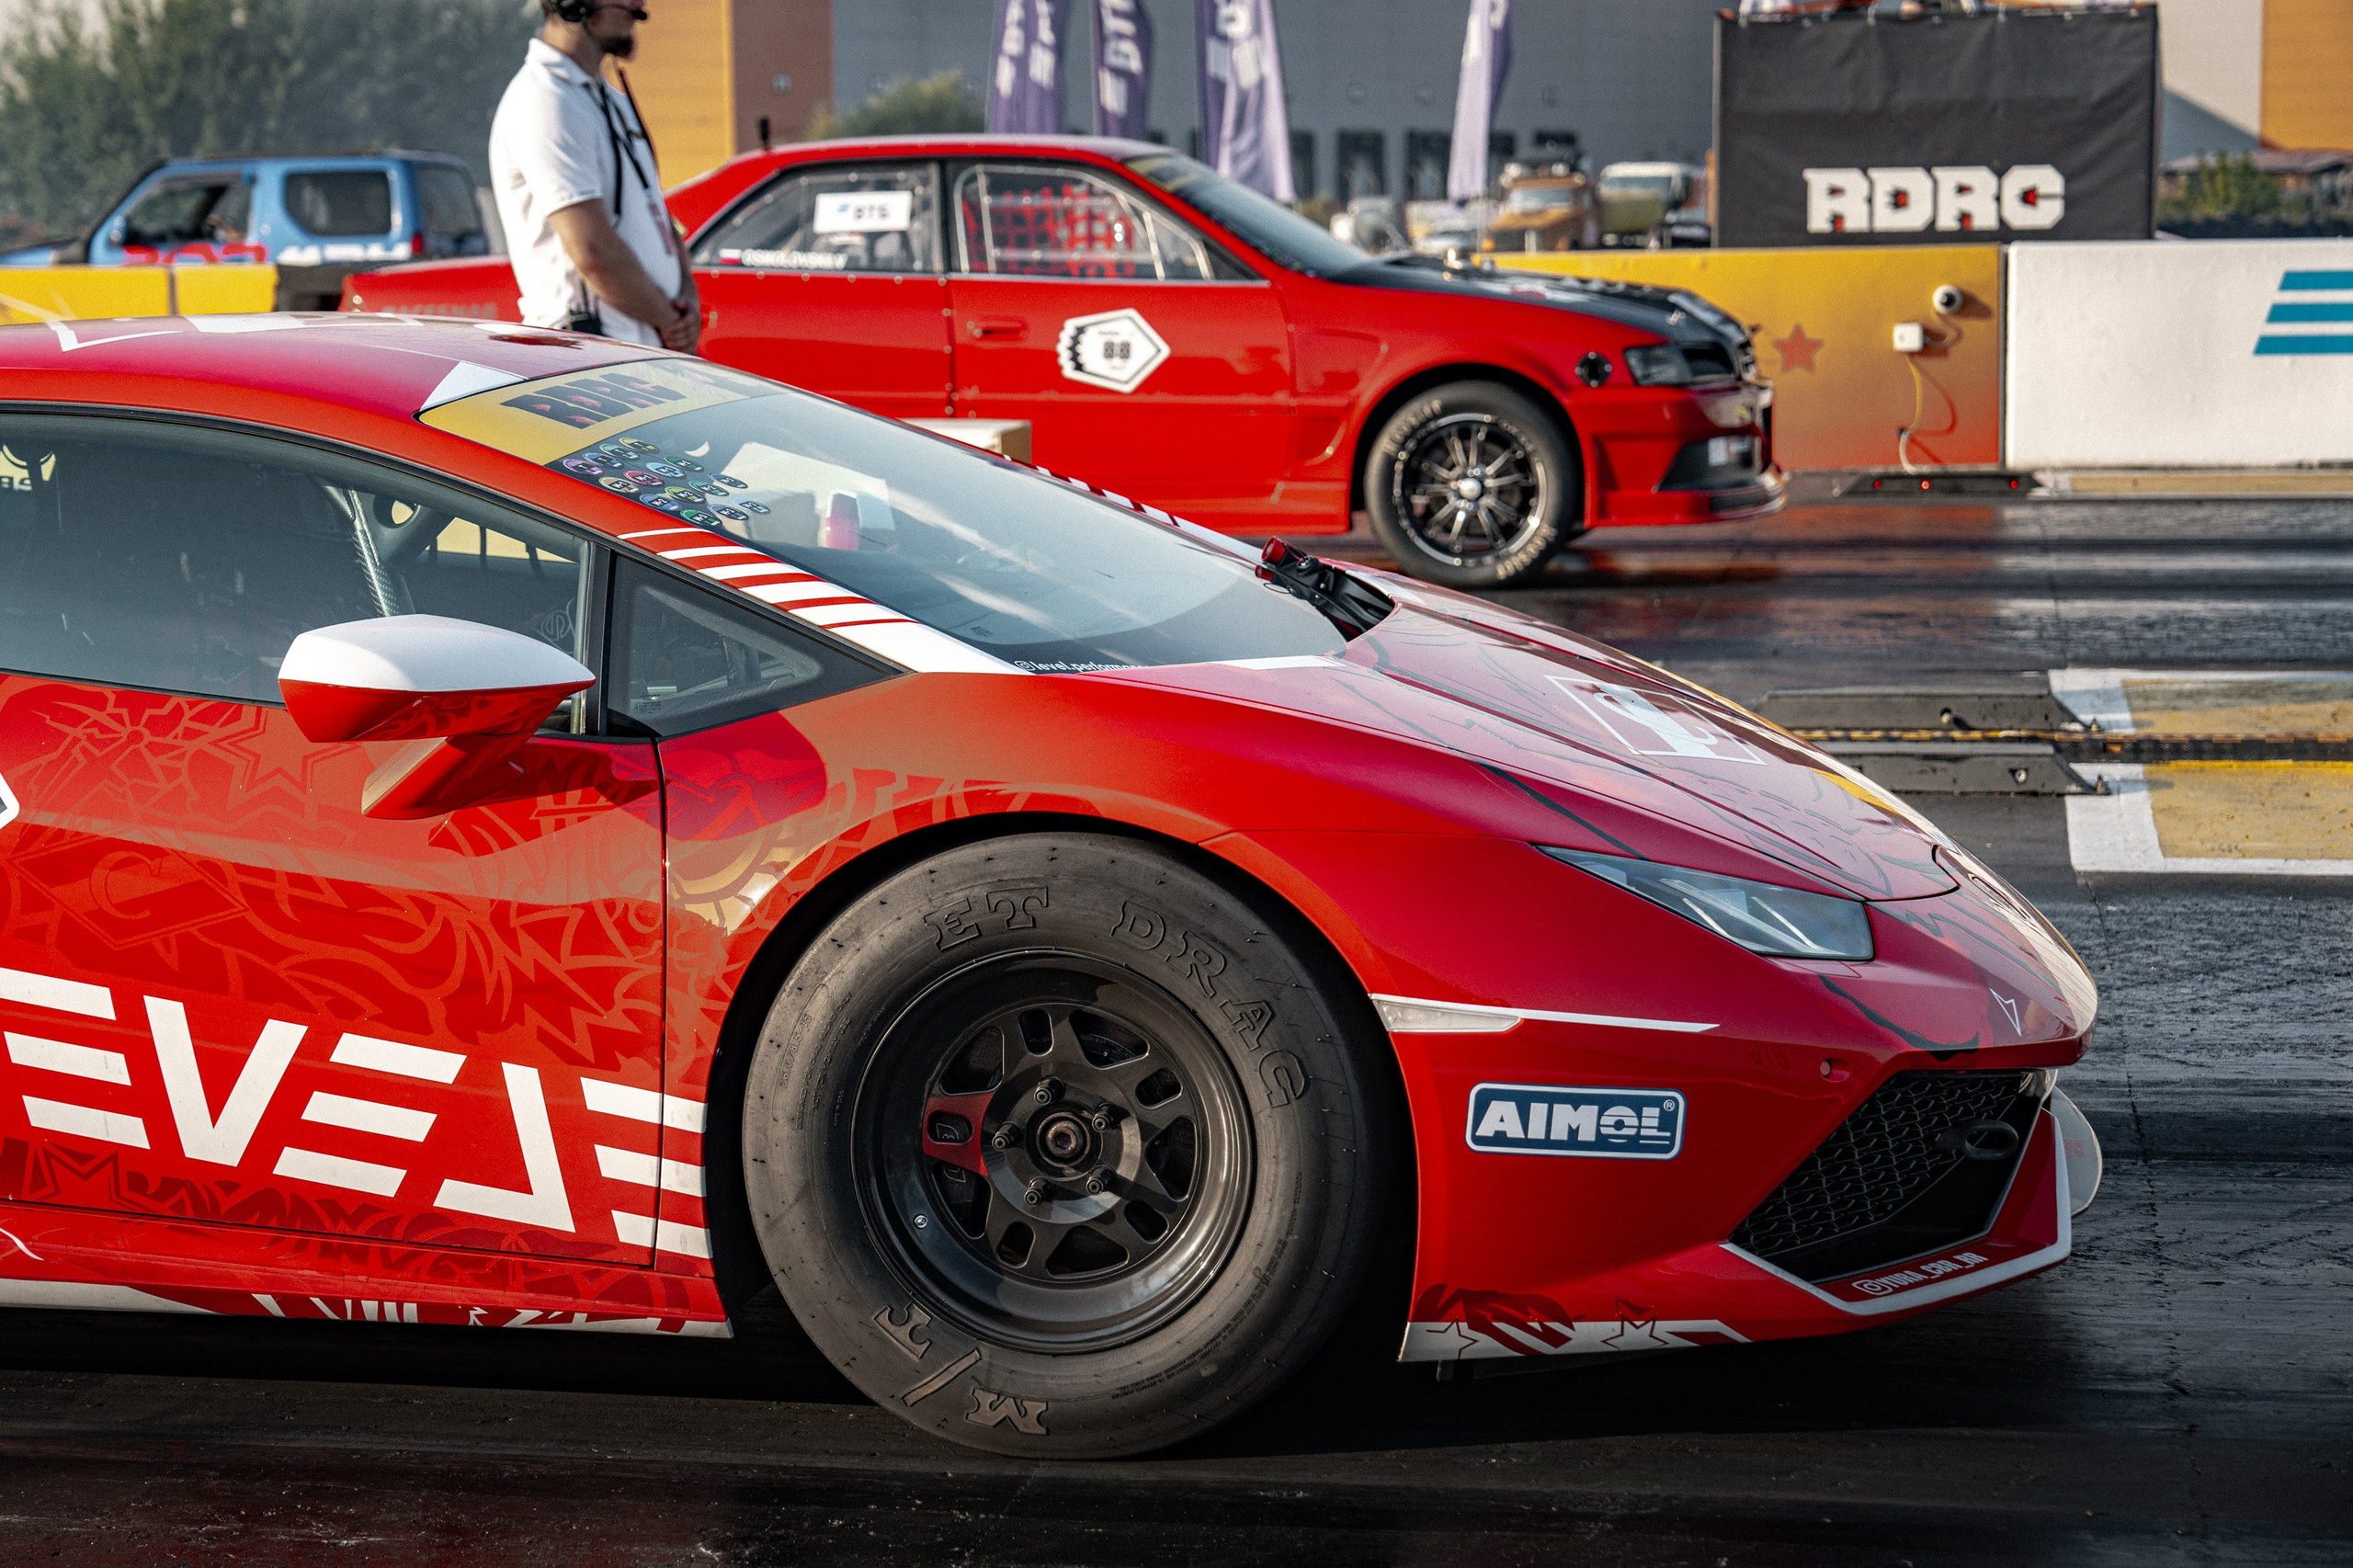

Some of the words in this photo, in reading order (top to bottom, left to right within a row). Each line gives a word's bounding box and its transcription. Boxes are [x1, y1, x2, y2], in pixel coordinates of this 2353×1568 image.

[1802, 164, 2065, 233] RDRC
[924, 886, 1049, 951] ET
[1110, 900, 1310, 1108] DRAG
